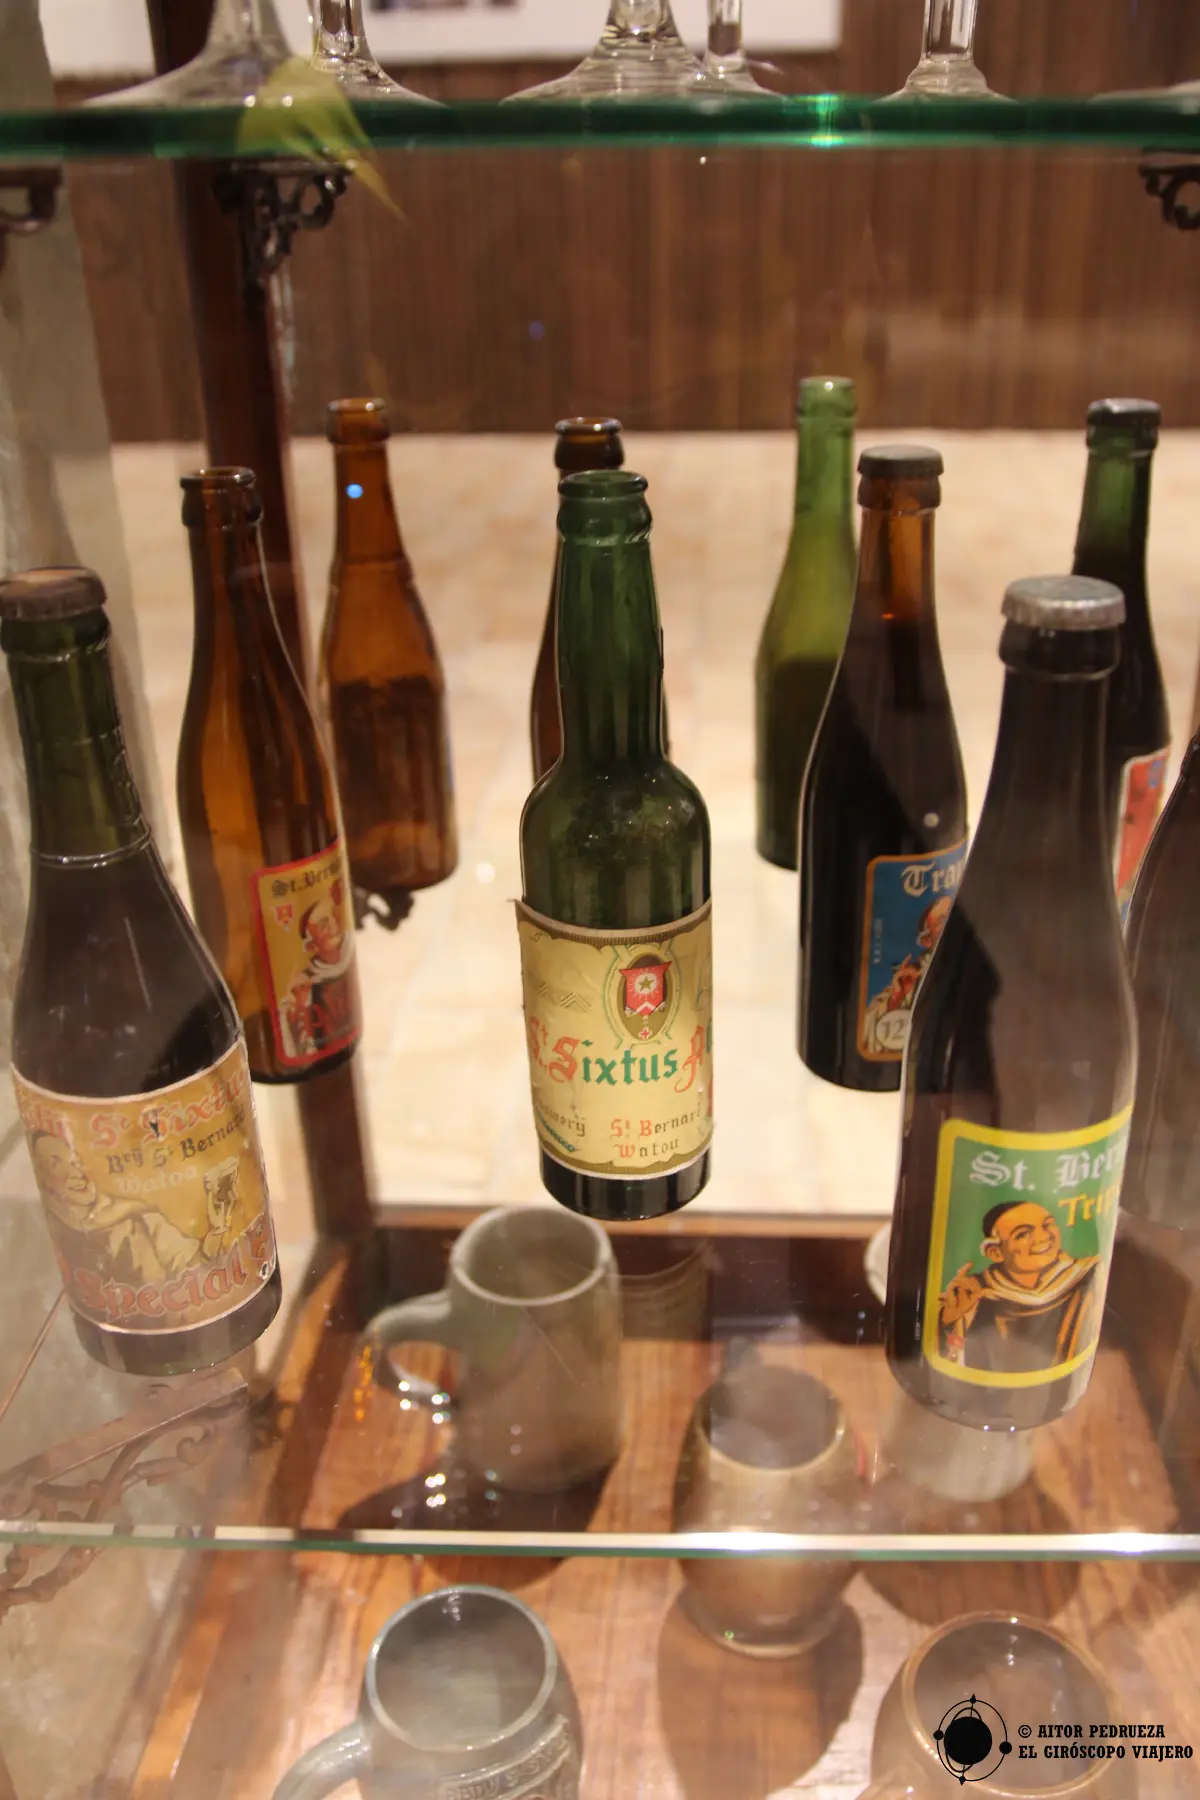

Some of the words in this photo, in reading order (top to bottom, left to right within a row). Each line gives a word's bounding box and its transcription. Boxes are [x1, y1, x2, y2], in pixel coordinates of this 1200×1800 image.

[548, 1036, 678, 1086] Sixtus
[969, 1150, 1036, 1191] St.
[73, 1238, 250, 1323] Special
